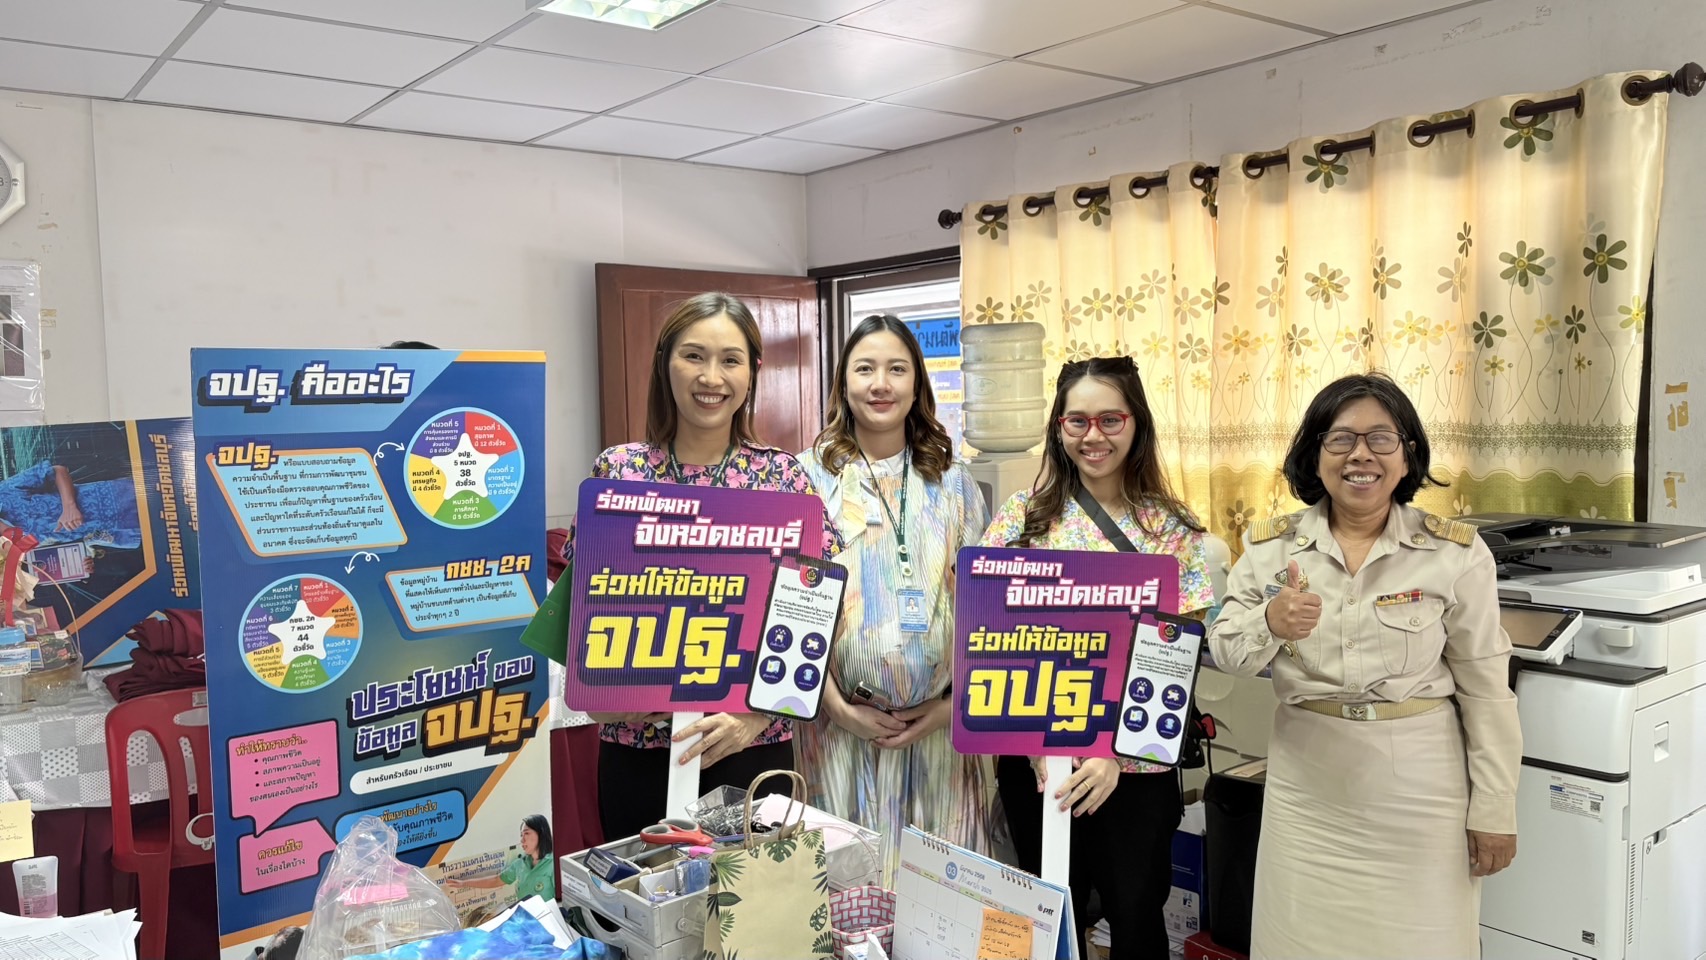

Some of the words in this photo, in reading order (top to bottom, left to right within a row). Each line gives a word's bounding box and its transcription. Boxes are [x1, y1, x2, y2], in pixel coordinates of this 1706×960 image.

[208, 367, 287, 404] จปฐ.
[300, 362, 412, 396] คืออะไร
[431, 419, 453, 428] หมวดที่
[474, 423, 496, 431] หมวดที่
[217, 442, 278, 470] จปฐ.
[283, 456, 356, 468] หรือแบบสอบถามข้อมูล
[457, 450, 473, 459] จปฐ.
[232, 470, 297, 484] ความจำเป็นพื้นฐาน
[299, 469, 367, 480] ที่กรมการพัฒนาชุมชน
[412, 468, 434, 477] หมวดที่
[459, 469, 472, 477] 38
[487, 466, 509, 474] หมวดที่
[238, 482, 370, 496] ใช้เป็นเครื่องมือตรวจสอบคุณภาพชีวิตของ
[455, 478, 476, 487] ตัวชี้วัด
[244, 500, 278, 509] ประชาชน
[279, 493, 383, 507] เพื่อแก้ปัญหาพื้นฐานของครัวเรือน
[452, 496, 474, 505] หมวดที่
[596, 488, 700, 516] ร่วมพัฒนา
[149, 434, 189, 598] ร่วมพัฒนาจังหวัดชลบุรี
[256, 518, 383, 535] ส่วนราชการและส่วนท้องถิ่นเข้ามาดูแลใน
[262, 539, 287, 548] อนาคต
[288, 532, 358, 546] ซึ่งจะจัดเก็บข้อมูลทุกปี
[634, 515, 803, 557] จังหวัดชลบุรี
[445, 558, 491, 580] กชช.
[499, 554, 532, 574] 2ค
[971, 556, 1063, 577] ร่วมพัฒนา
[272, 584, 293, 593] หมวดที่
[400, 576, 438, 588] ข้อมูลหมู่บ้าน
[405, 580, 513, 598] ที่แสดงให้เห็นสภาพทั่วไปและปัญหาของ
[589, 566, 746, 605] ร่วมให้ข้อมูล
[476, 590, 517, 603] เป็นข้อมูลที่เก็บ
[1006, 578, 1160, 614] จังหวัดชลบุรี
[246, 614, 268, 624] หมวดที่
[454, 608, 460, 617] ปี
[297, 633, 309, 642] 44
[585, 606, 742, 685] จปฐ.
[968, 625, 1107, 658] ร่วมให้ข้อมูล
[253, 646, 274, 656] หมวดที่
[293, 643, 315, 652] ตัวชี้วัด
[352, 648, 493, 721] ประโยชน์
[493, 655, 533, 682] ของ
[968, 661, 1106, 732] จปฐ.
[356, 718, 418, 755] ข้อมูล
[425, 688, 533, 749] จปฐ.
[262, 750, 302, 764] คุณภาพชีวิต
[262, 756, 321, 775] สภาพความเป็นอยู่
[366, 767, 418, 785] สำหรับครัวเรือน
[424, 760, 453, 773] ประชาชน
[263, 771, 316, 788] และสภาพปัญหา
[250, 781, 318, 803] ของตนเองเป็นอย่างไร
[258, 839, 303, 861] ควรแก้ไข
[256, 858, 306, 876] ในเรื่องใดบ้าง
[947, 865, 956, 876] 03
[958, 873, 980, 890] March
[1042, 906, 1055, 917] ptt
